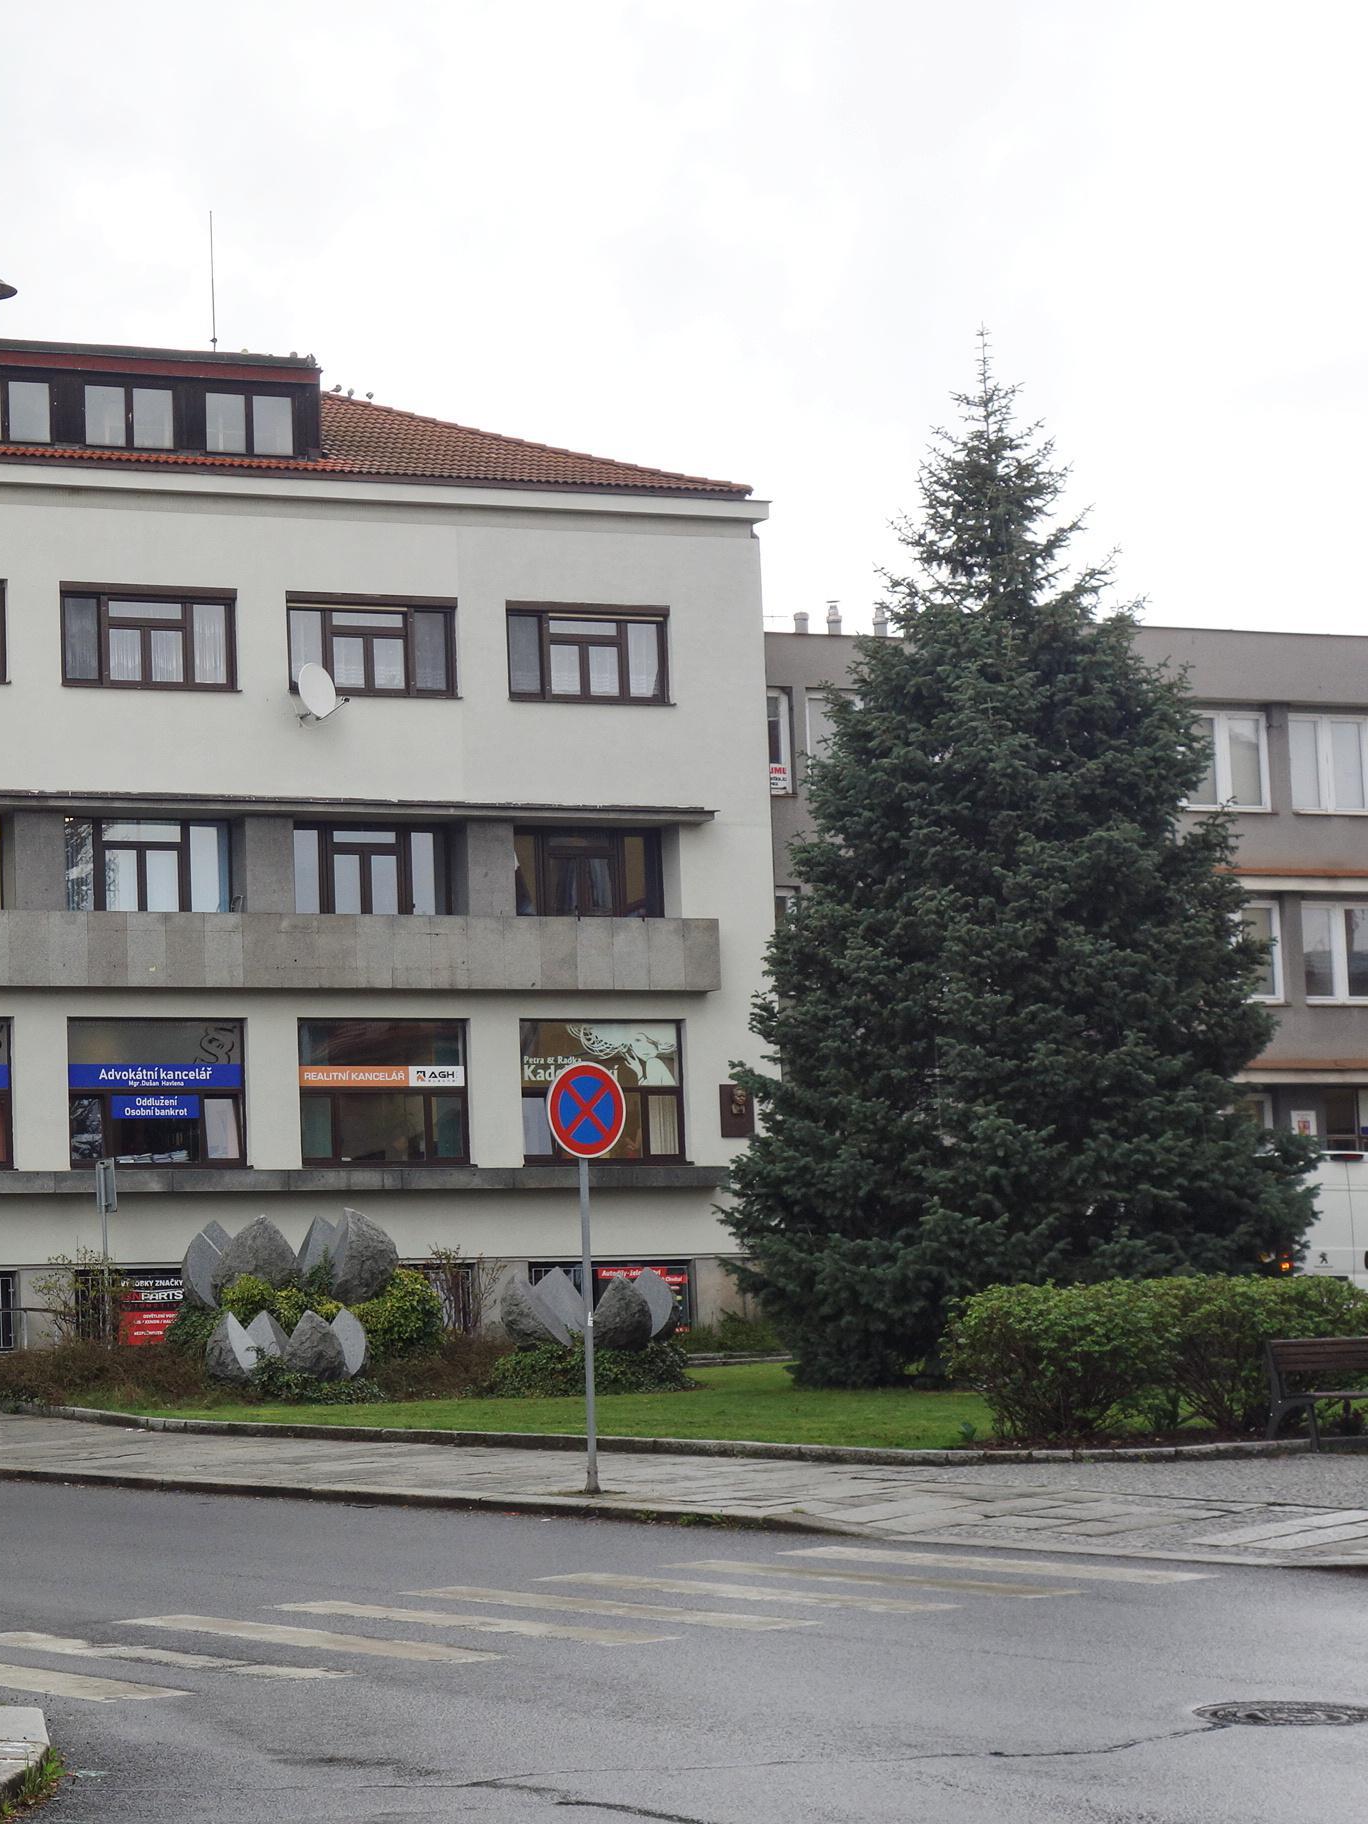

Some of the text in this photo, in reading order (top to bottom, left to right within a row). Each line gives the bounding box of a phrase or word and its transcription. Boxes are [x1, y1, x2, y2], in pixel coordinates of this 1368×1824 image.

[524, 1056, 544, 1064] Petra
[558, 1056, 582, 1064] Radka
[99, 1067, 213, 1080] Advokátní kancelář
[304, 1071, 405, 1081] REALITNÍ KANCELÁŘ
[428, 1071, 455, 1079] AGH
[135, 1096, 178, 1106] Oddlužení
[124, 1107, 187, 1116] Osobní bankrot
[120, 1278, 183, 1287] VÝOBKY ZNAČKY
